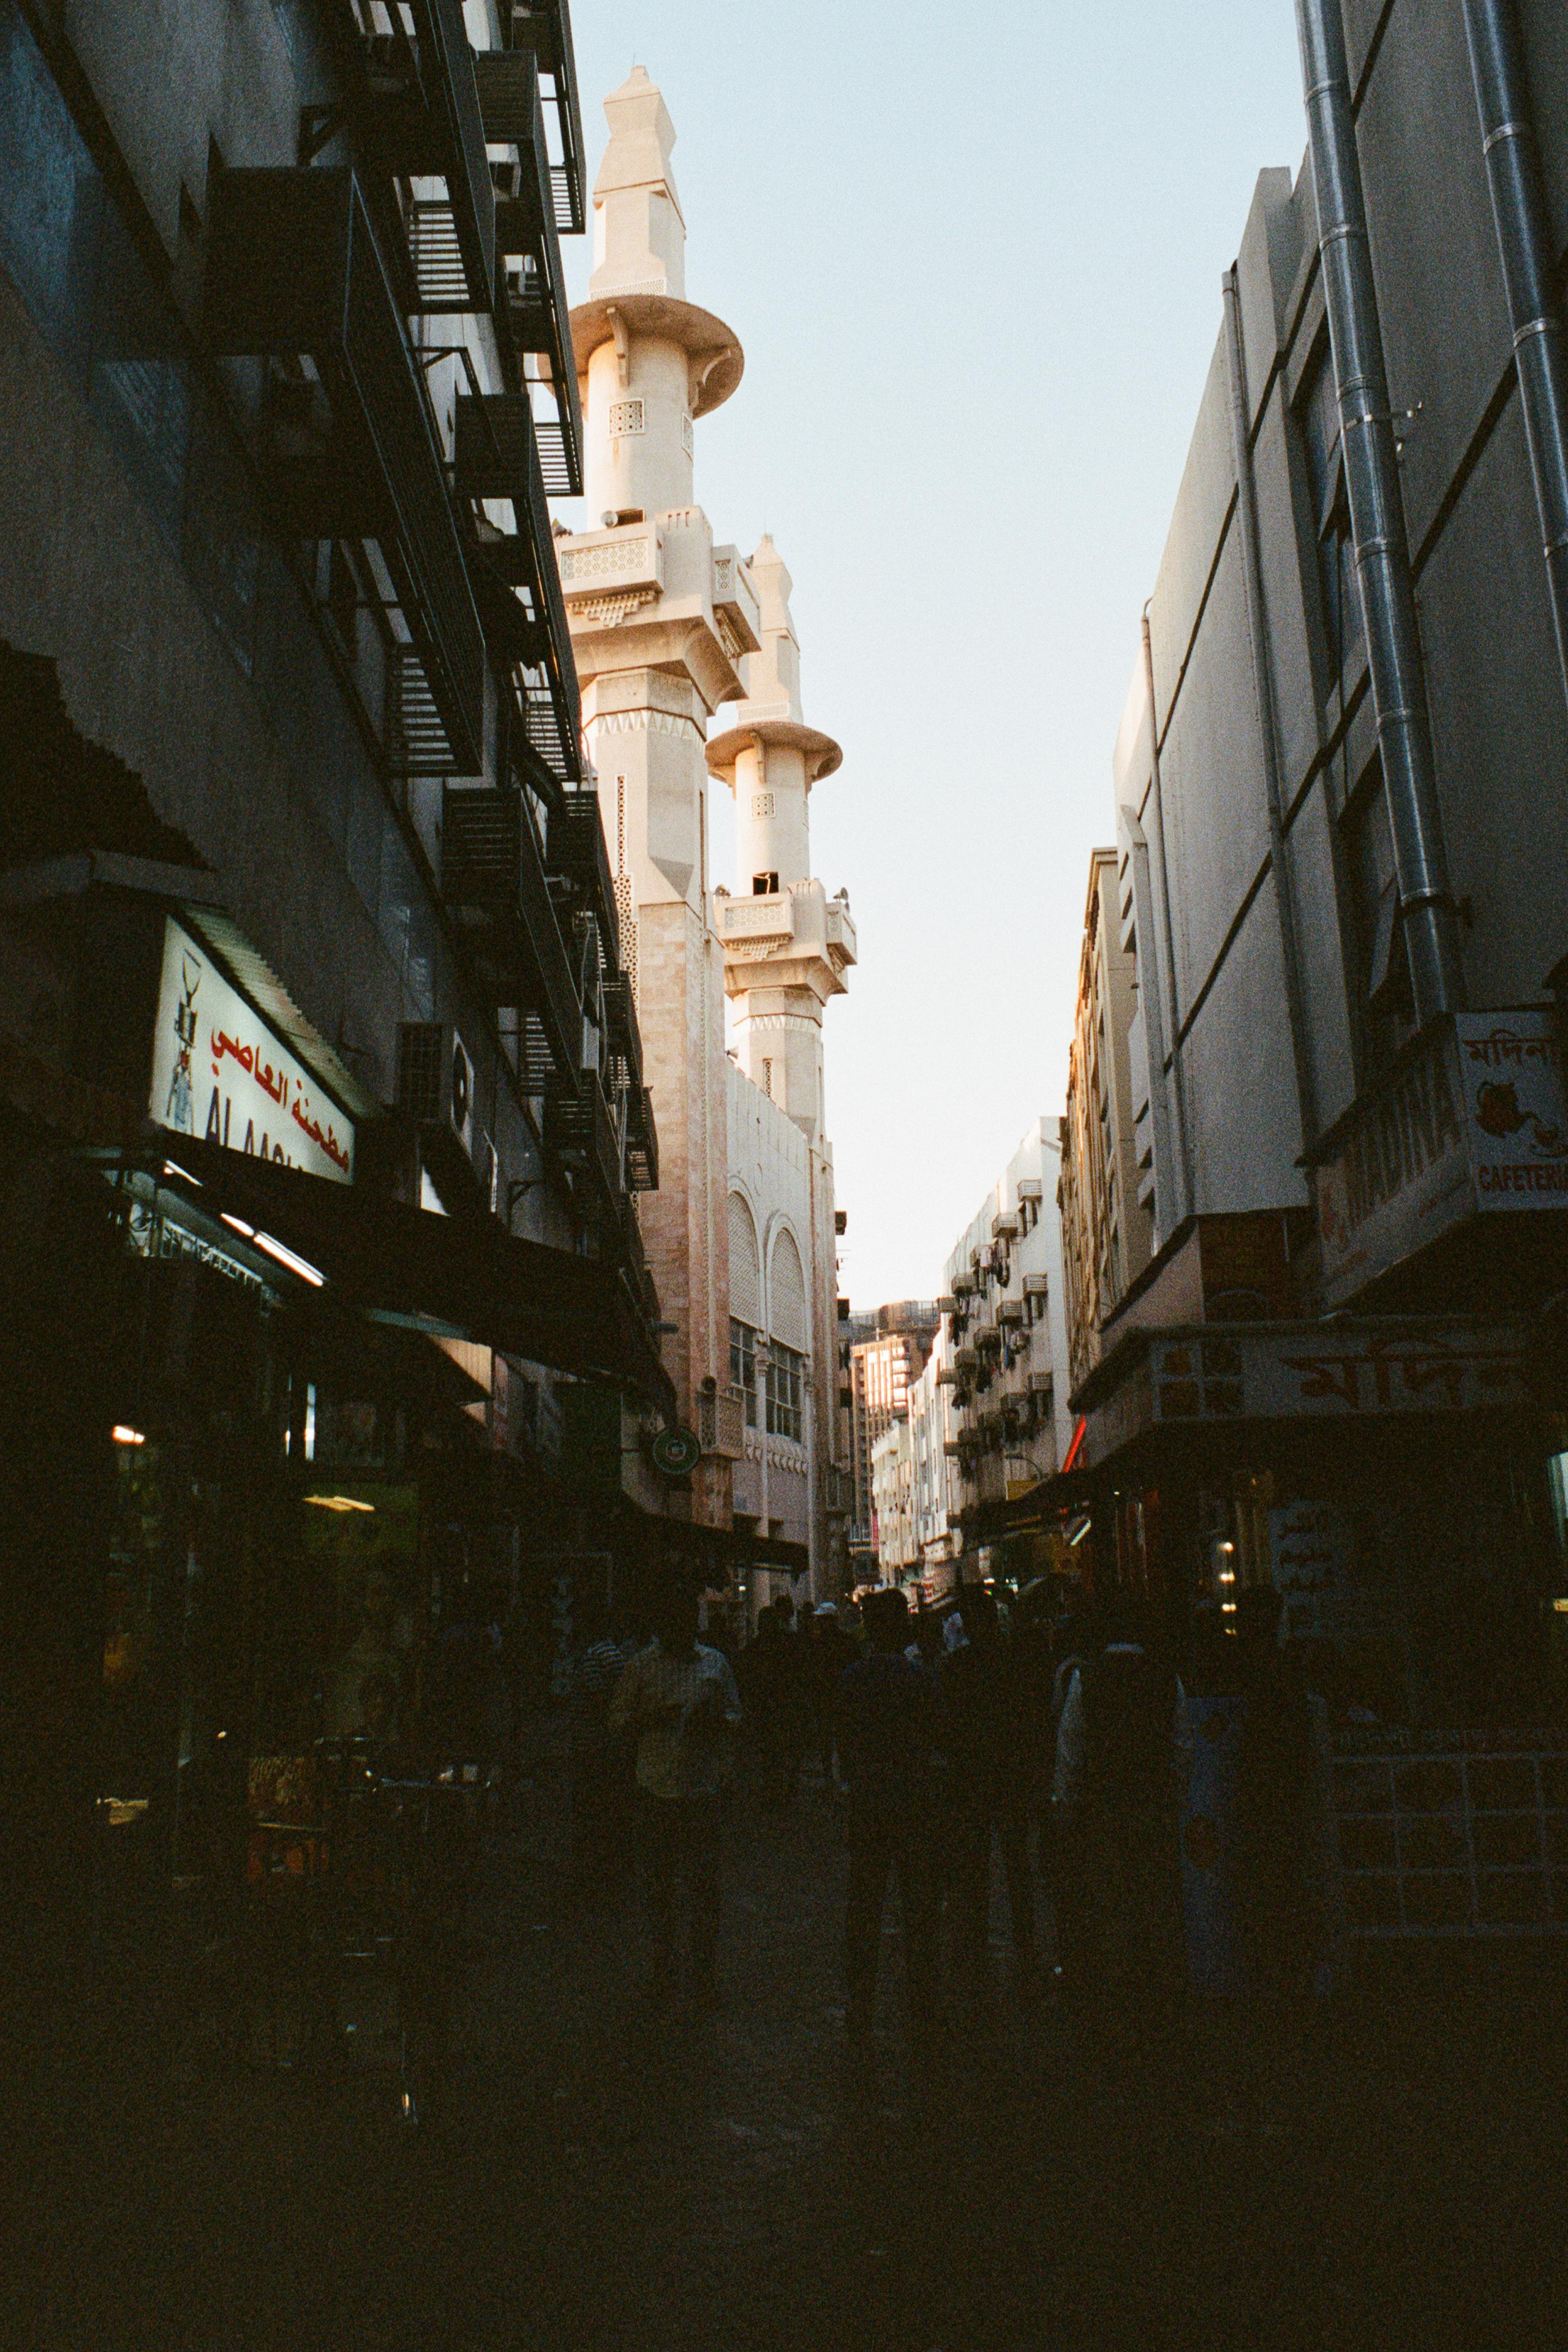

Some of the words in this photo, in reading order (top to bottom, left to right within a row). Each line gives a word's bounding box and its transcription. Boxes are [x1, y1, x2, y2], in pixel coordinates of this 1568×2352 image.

[211, 1029, 288, 1109] العاصي
[291, 1078, 350, 1174] مطحنة
[1478, 1164, 1568, 1192] CAFETERI
